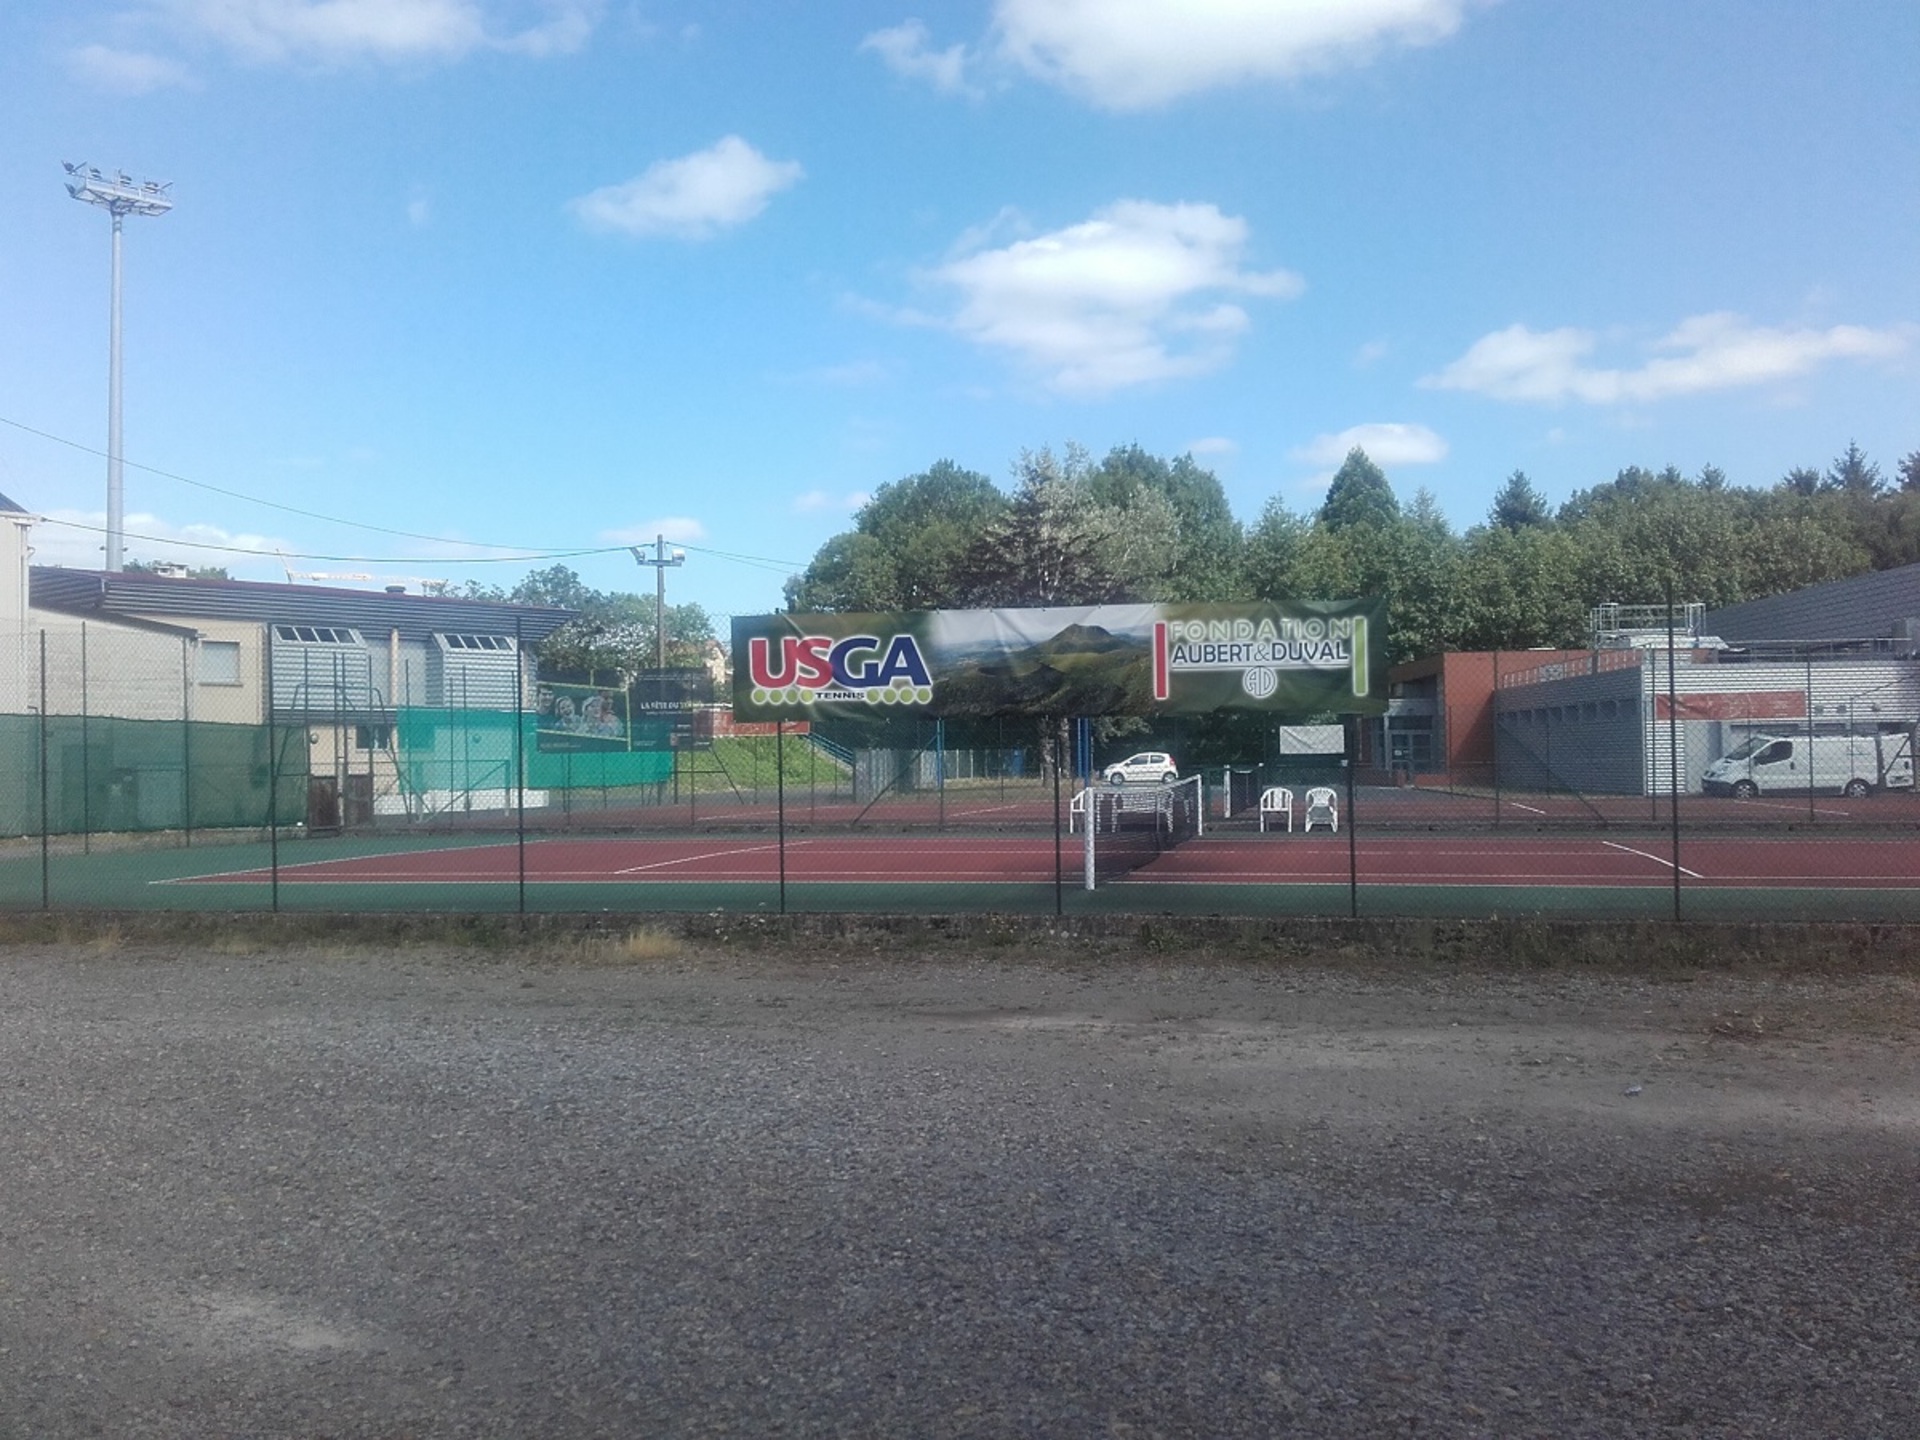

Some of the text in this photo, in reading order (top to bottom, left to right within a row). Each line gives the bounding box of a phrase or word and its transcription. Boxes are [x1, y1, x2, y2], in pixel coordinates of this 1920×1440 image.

[1170, 618, 1350, 642] FONDATION
[749, 635, 933, 690] USGA
[1172, 641, 1349, 664] AUBERT&DUVAL
[815, 691, 865, 700] TENNIS
